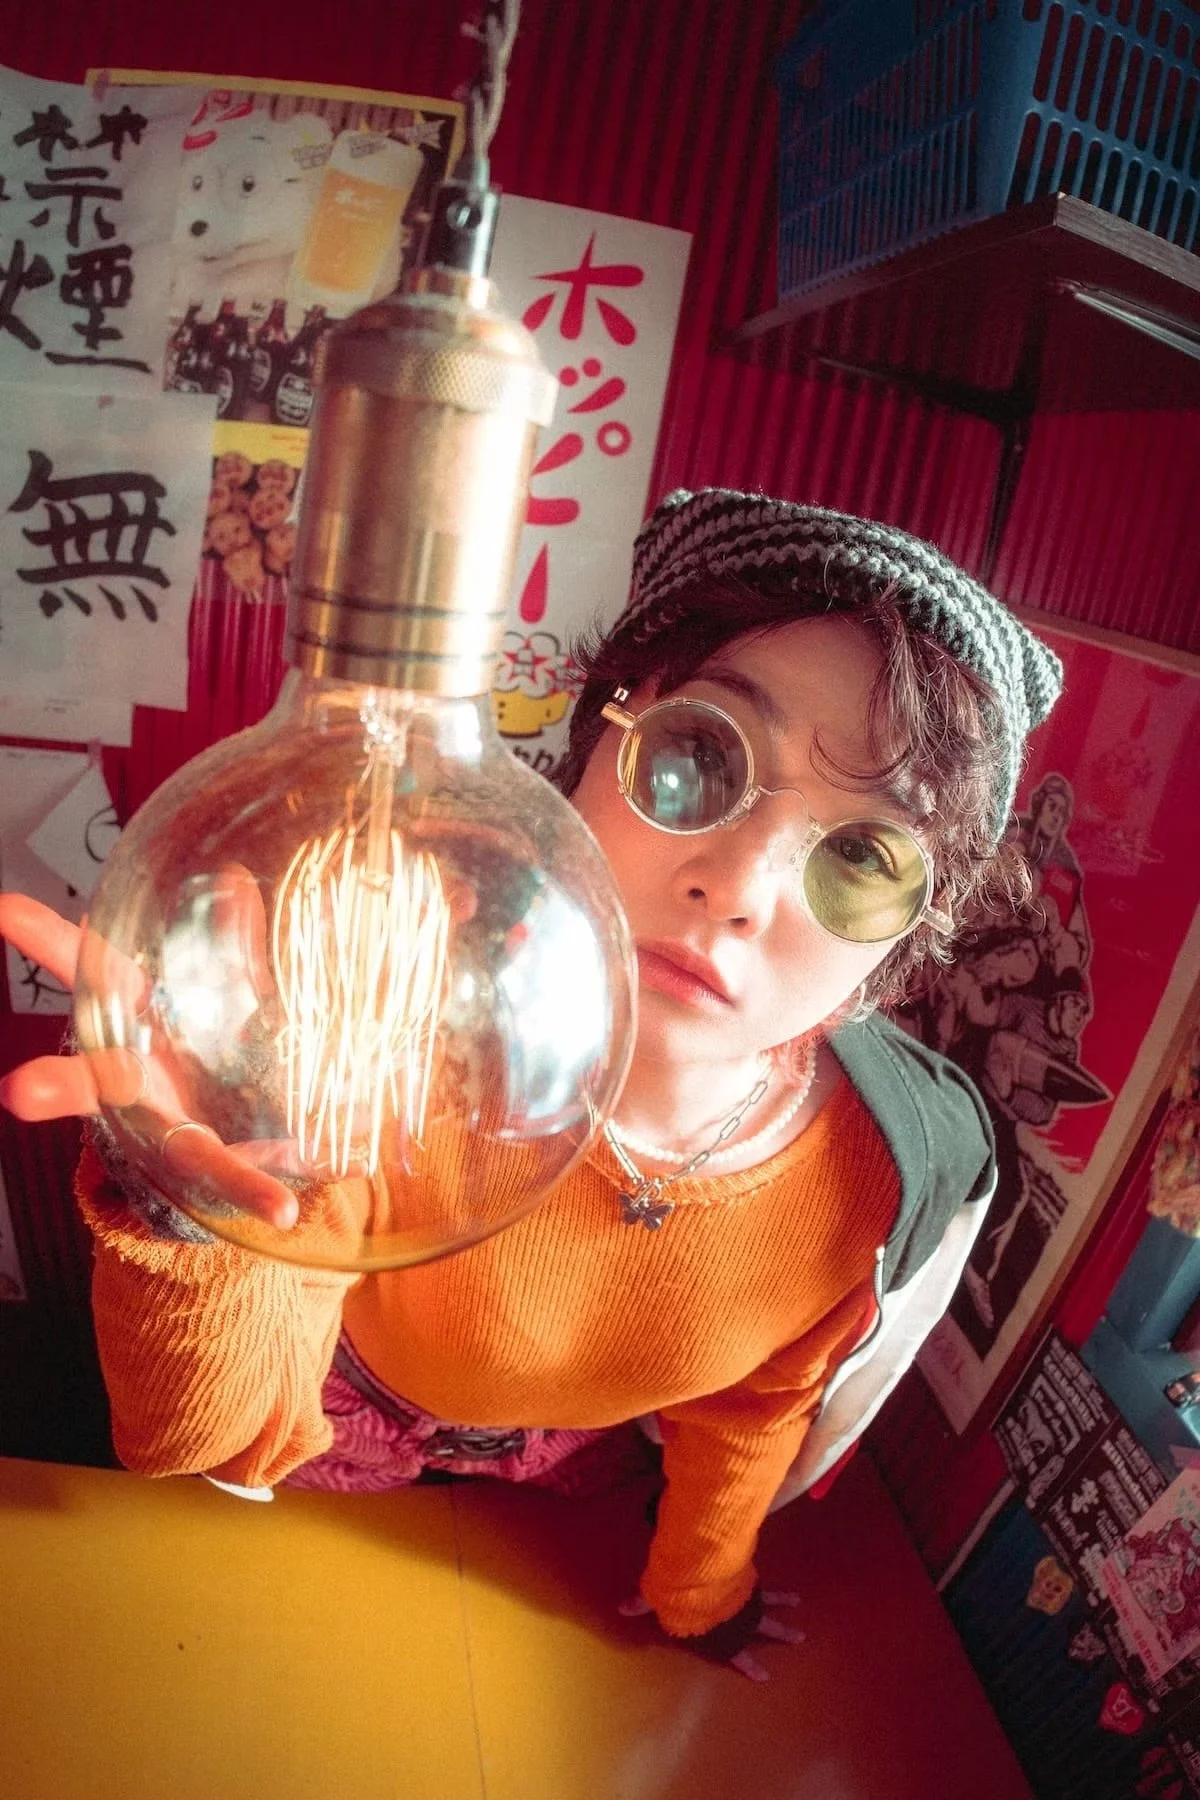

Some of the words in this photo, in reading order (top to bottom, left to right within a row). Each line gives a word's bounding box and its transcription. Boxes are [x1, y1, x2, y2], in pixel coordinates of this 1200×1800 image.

[0, 104, 152, 374] 禁煙
[9, 450, 177, 623] 無
[519, 231, 644, 624] ホッピー
